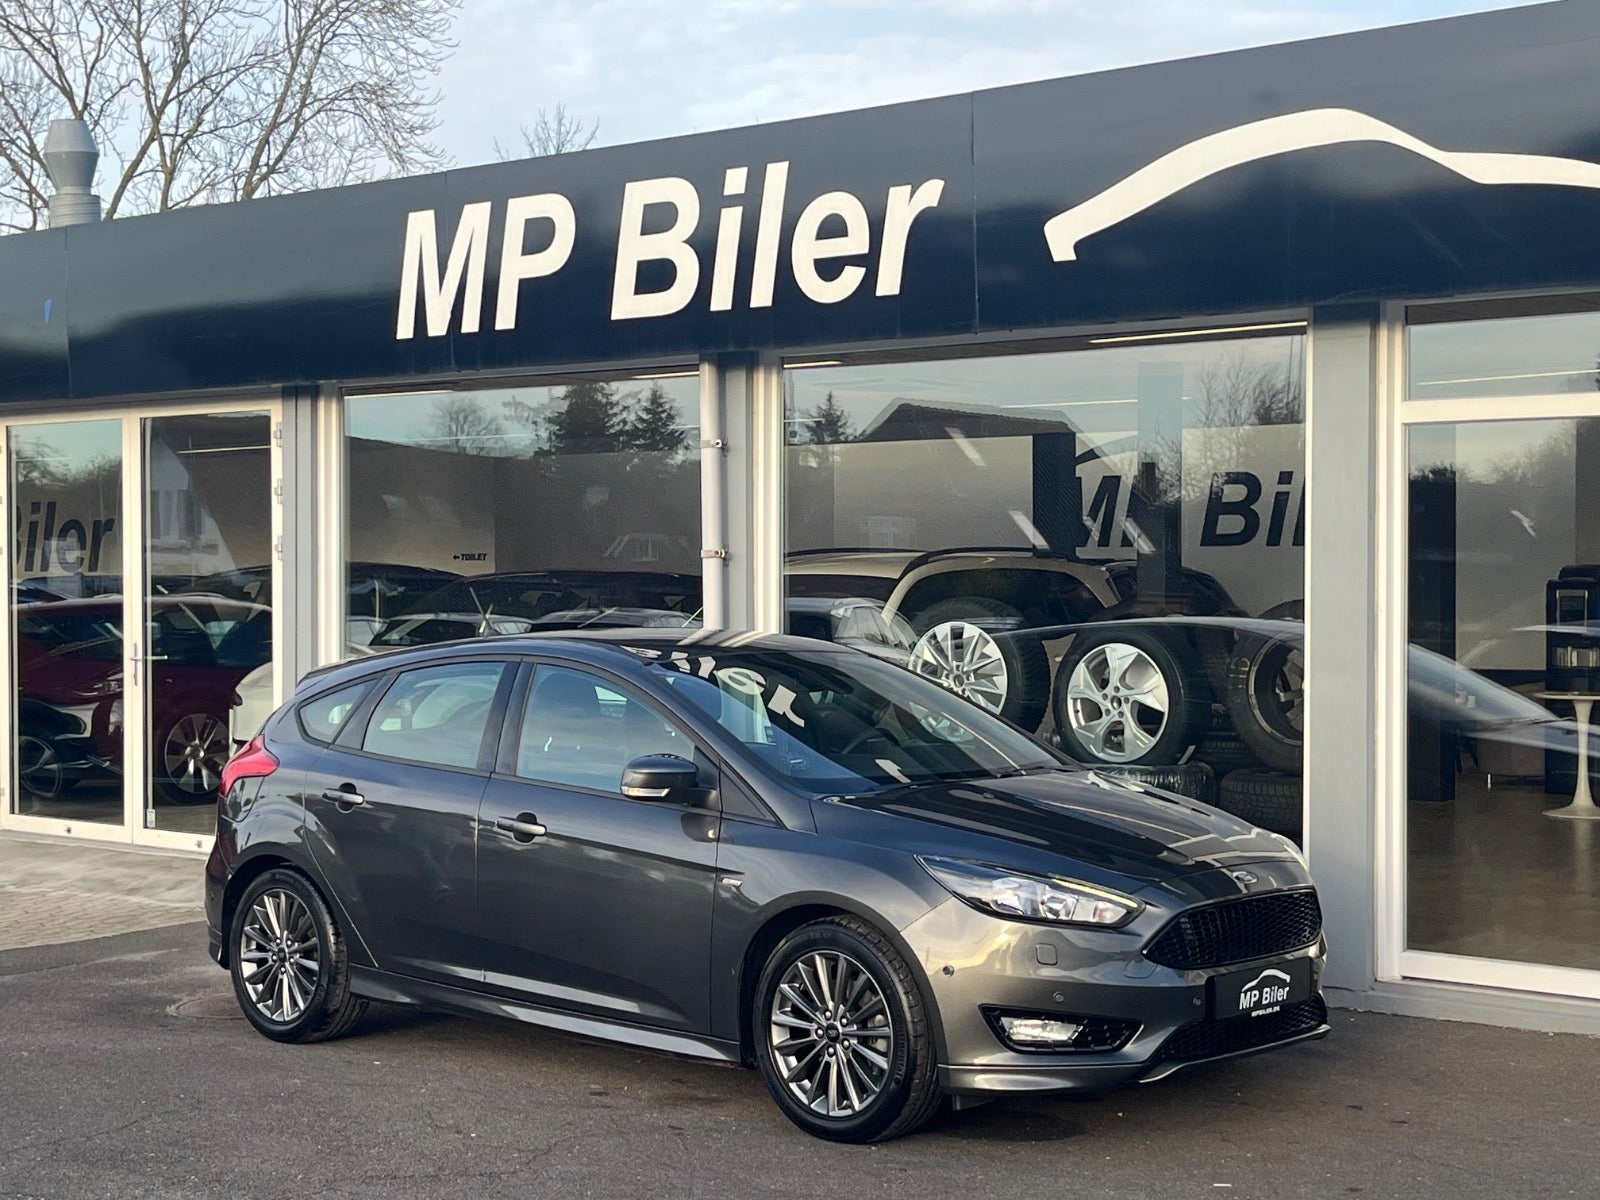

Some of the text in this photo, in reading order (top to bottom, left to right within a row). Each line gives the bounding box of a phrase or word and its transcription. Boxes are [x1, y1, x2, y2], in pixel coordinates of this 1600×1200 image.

[396, 160, 946, 340] MP Biler
[460, 553, 487, 561] TOILET
[1239, 985, 1290, 1010] MP Biler
